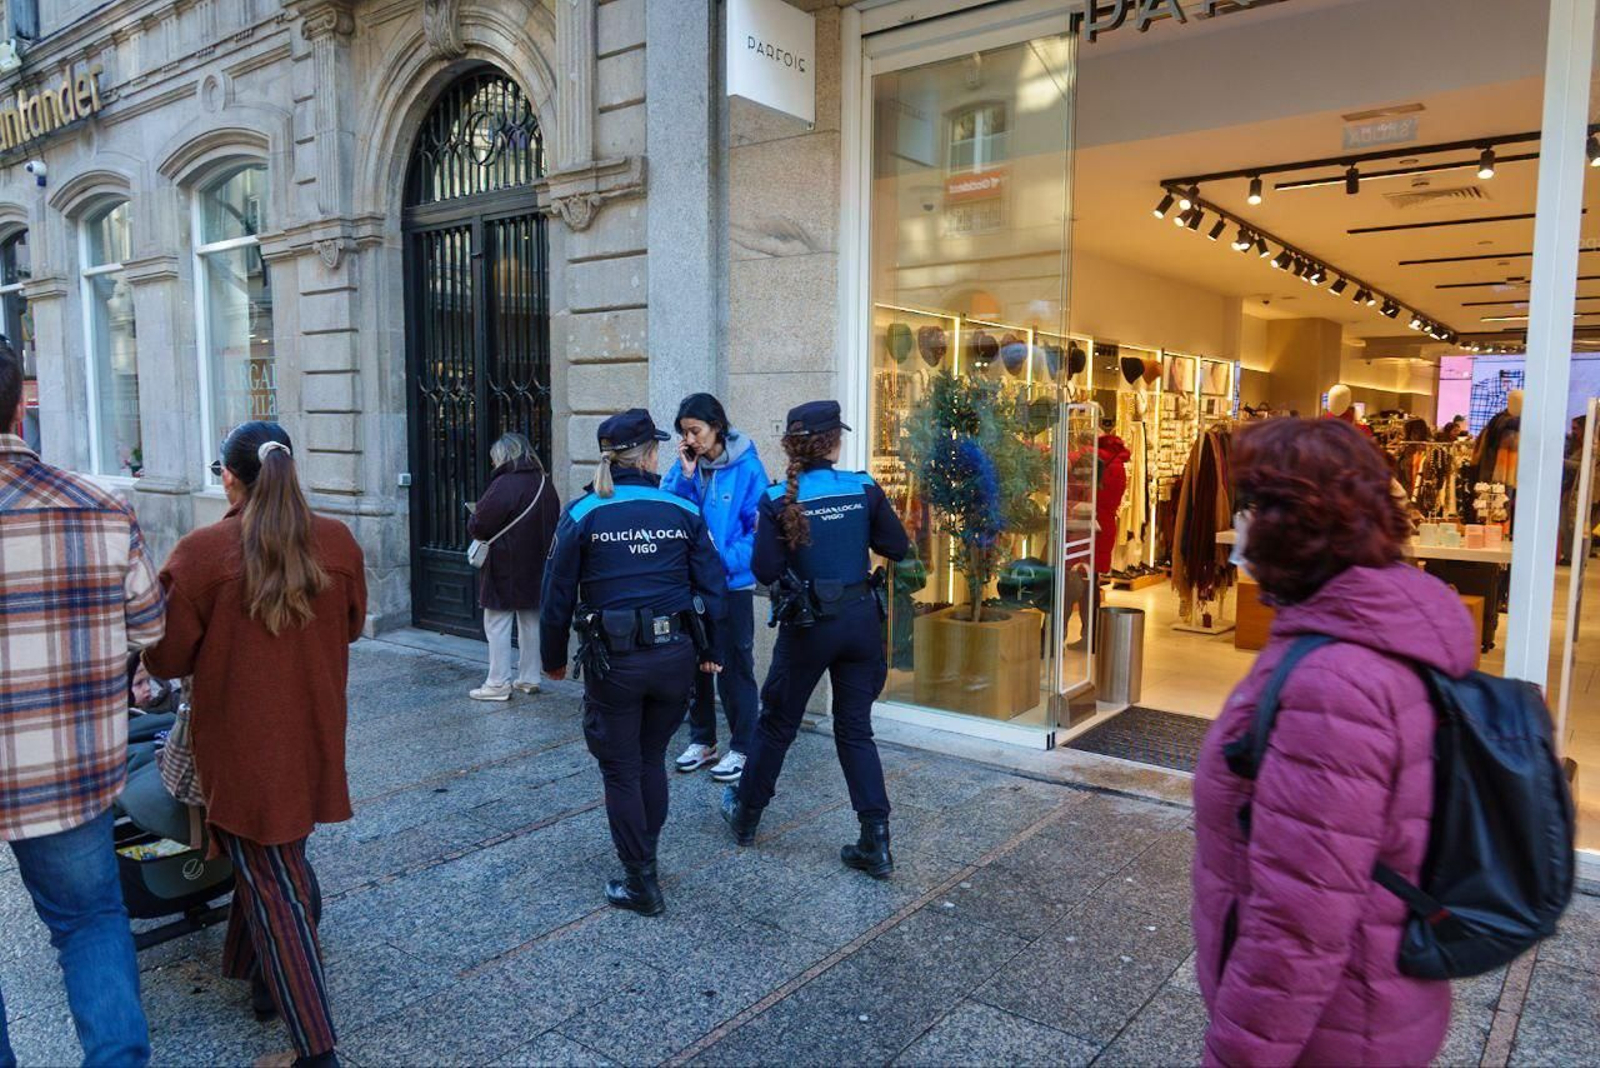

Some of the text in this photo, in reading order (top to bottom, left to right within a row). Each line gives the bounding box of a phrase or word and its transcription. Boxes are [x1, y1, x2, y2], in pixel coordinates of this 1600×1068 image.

[747, 35, 806, 73] PARFOIS
[838, 503, 865, 512] LOCAL
[821, 513, 845, 521] VIGO
[591, 528, 690, 543] POLICÍA LOCAL
[628, 543, 658, 554] VIGO
